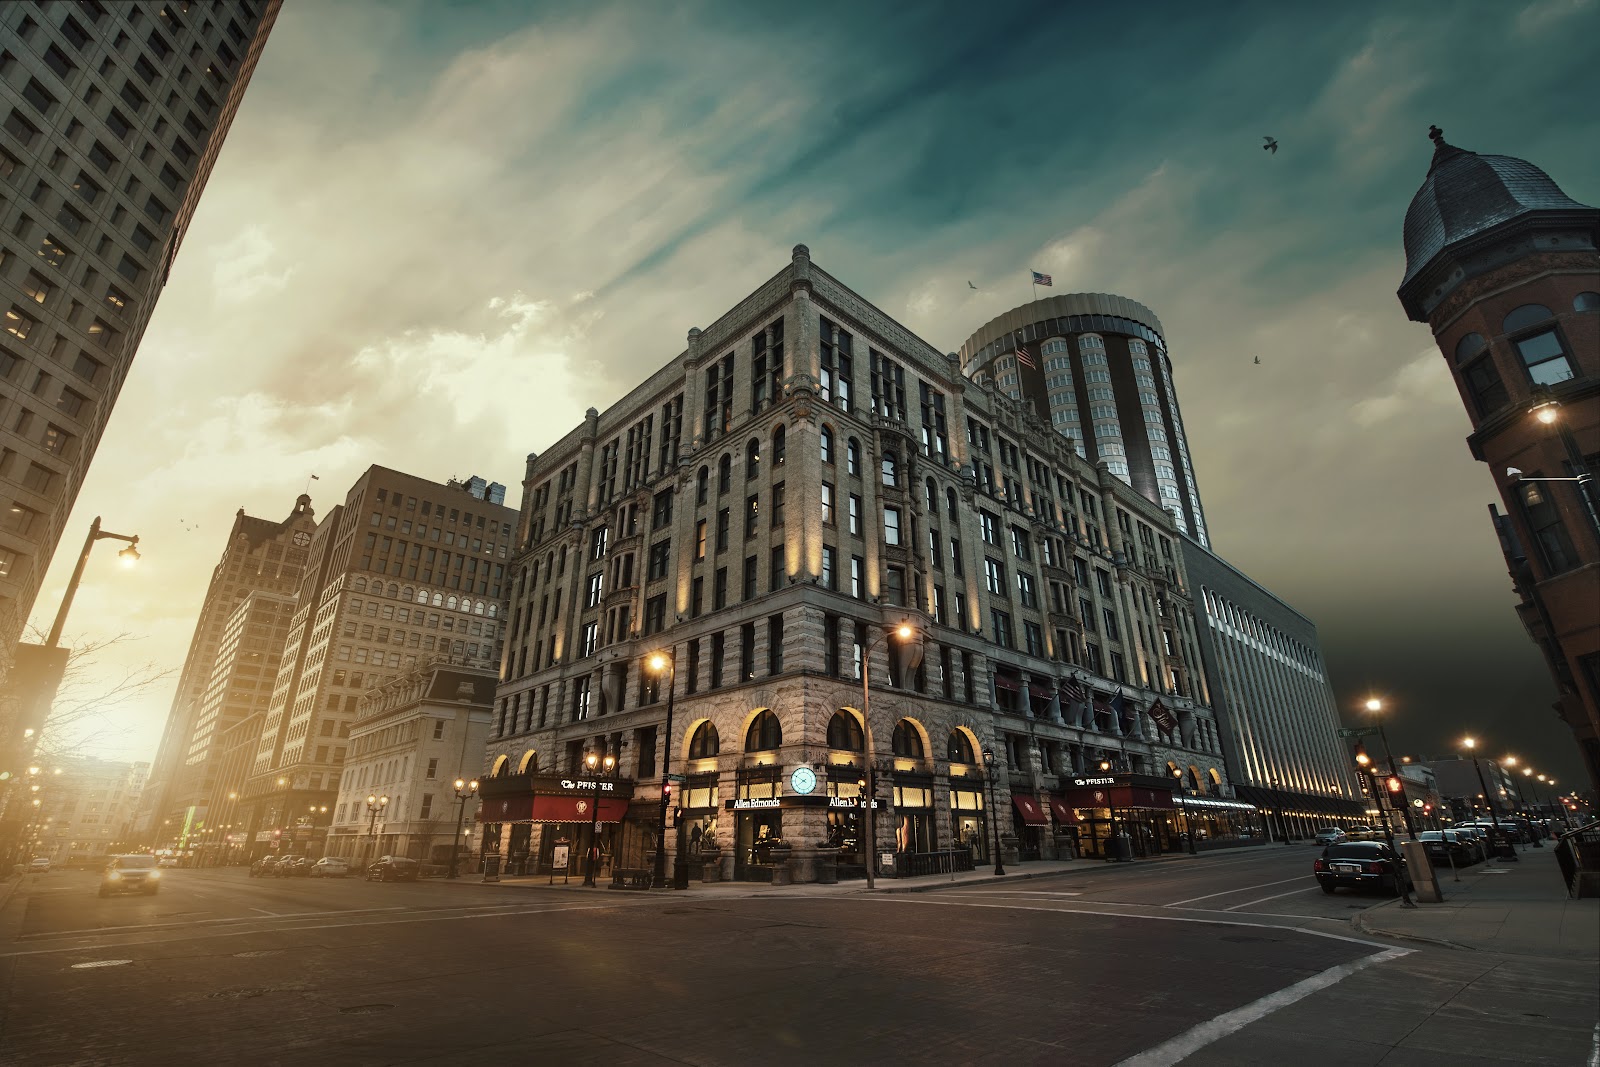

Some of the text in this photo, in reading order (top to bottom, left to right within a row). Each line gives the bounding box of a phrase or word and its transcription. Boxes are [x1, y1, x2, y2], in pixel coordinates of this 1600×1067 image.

[577, 781, 613, 791] PFISER
[734, 797, 780, 809] Allen Edmonds
[829, 797, 848, 807] Allen
